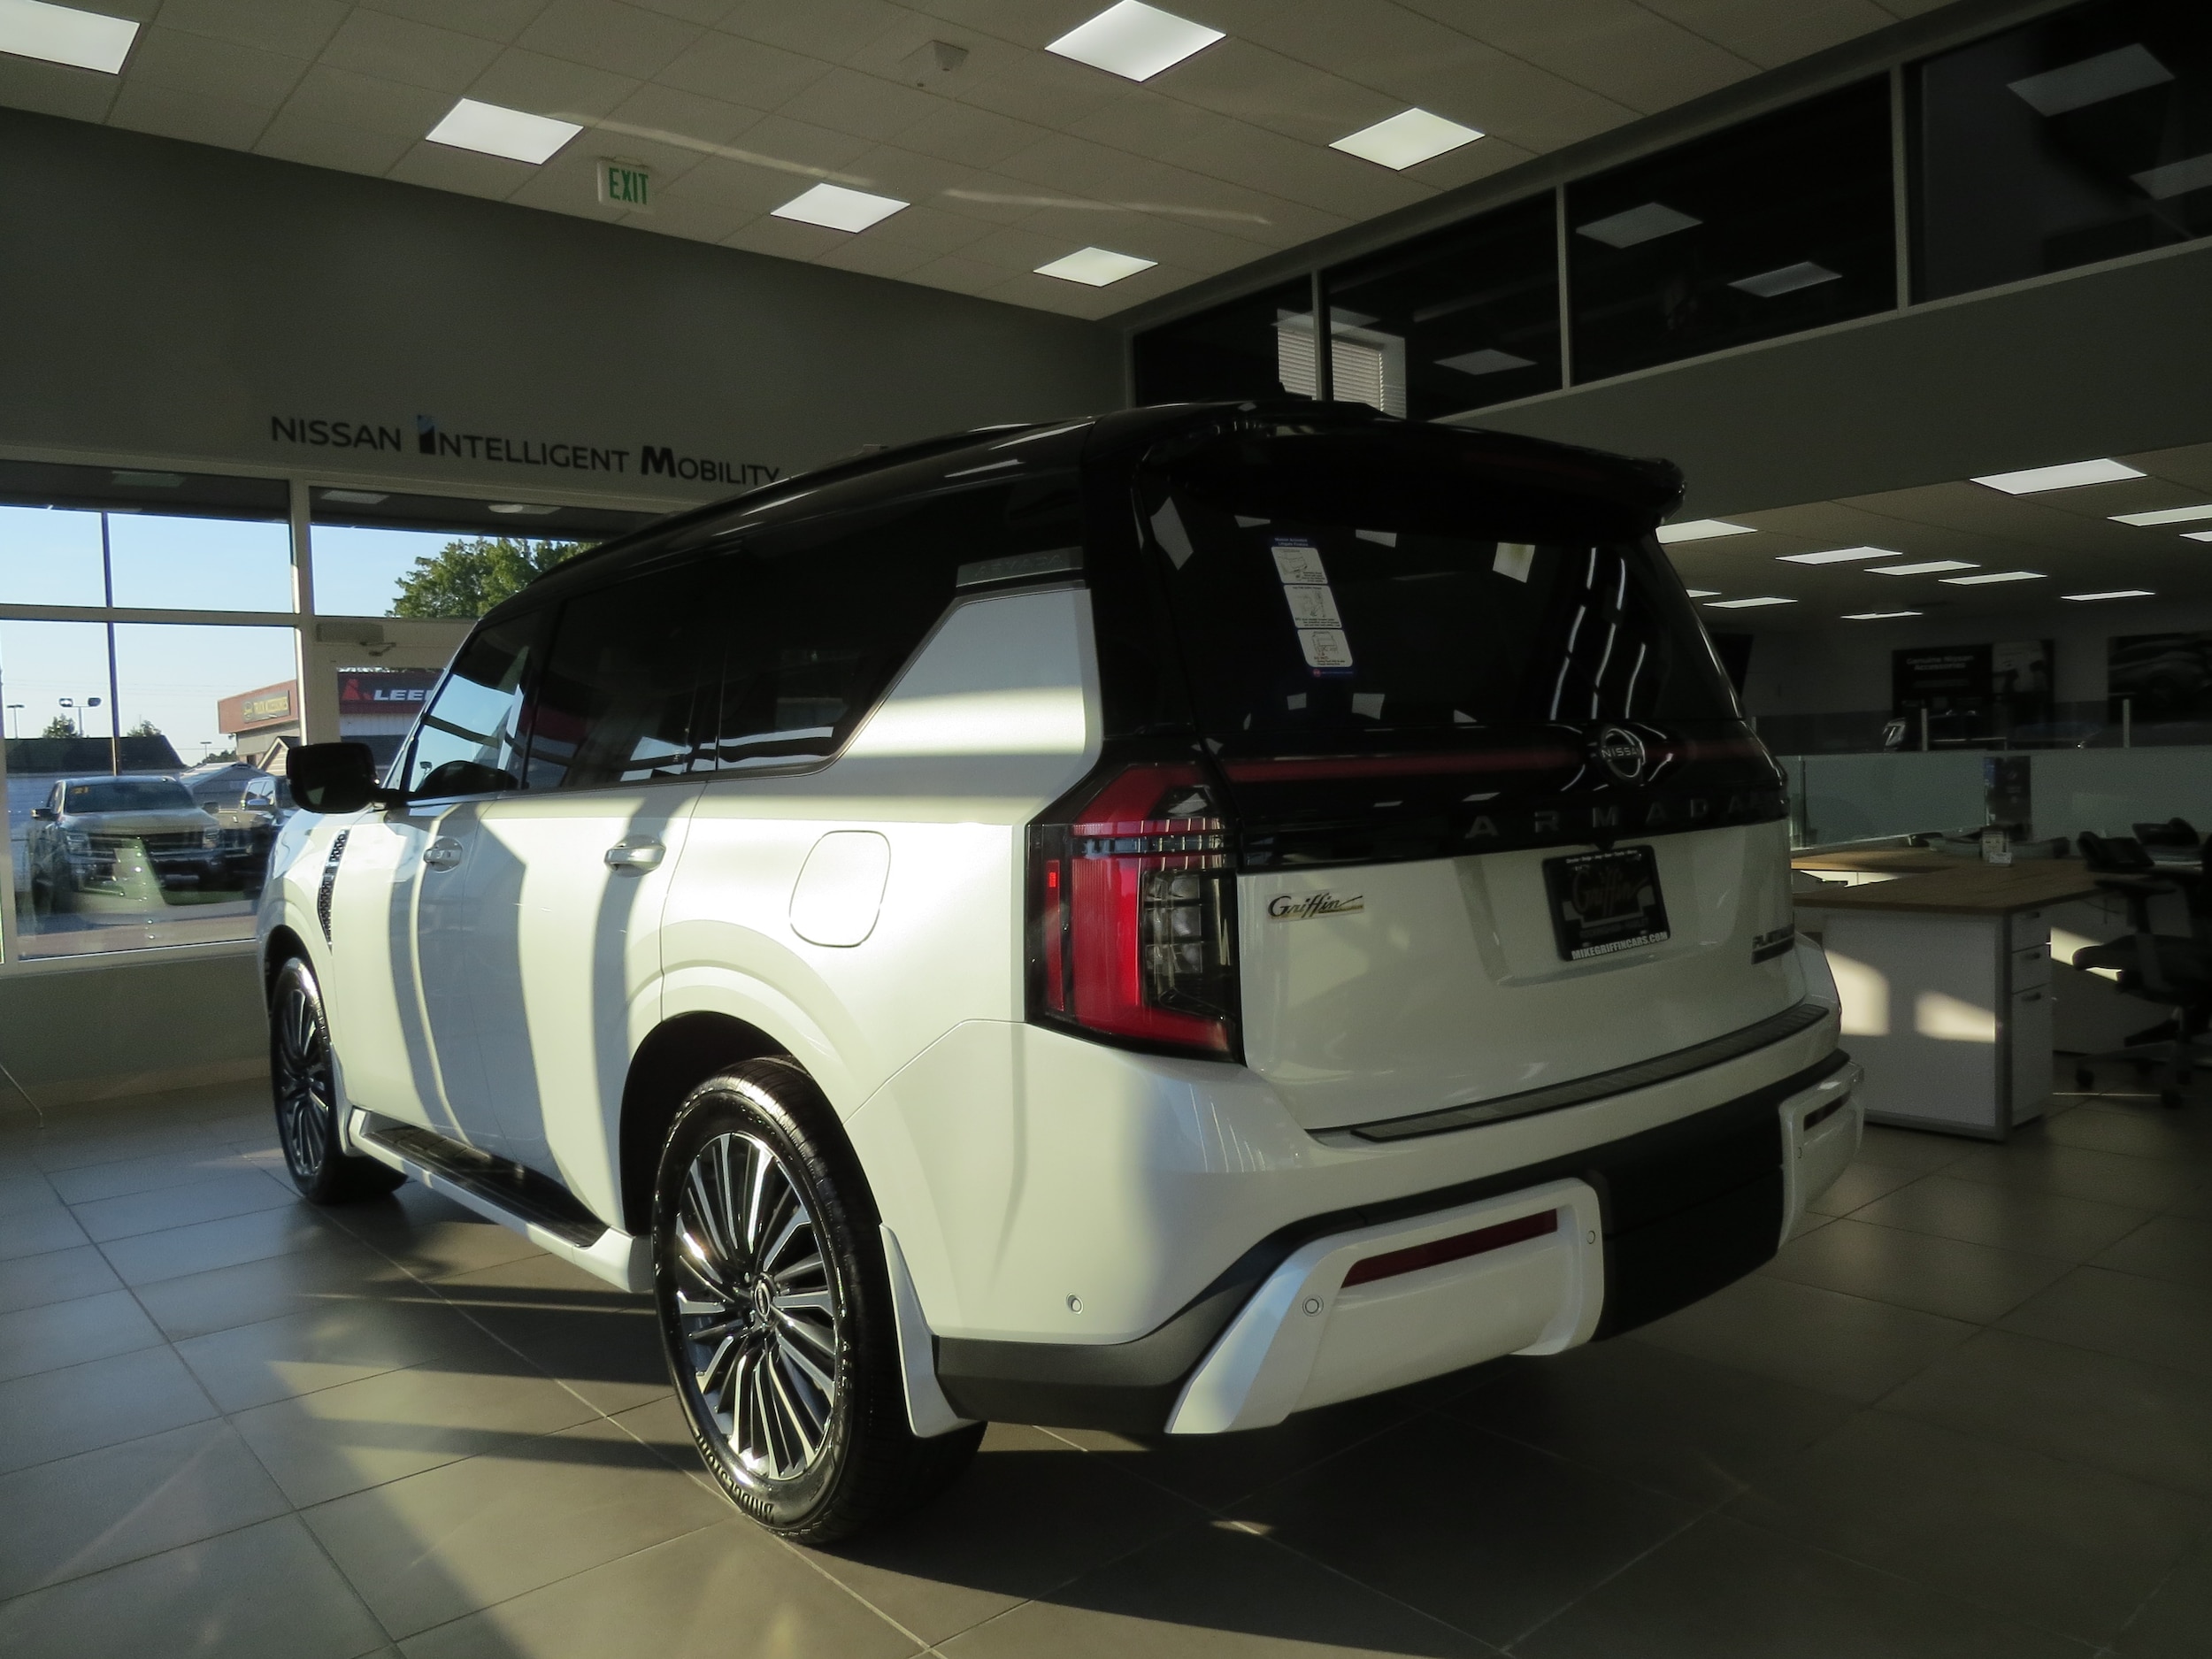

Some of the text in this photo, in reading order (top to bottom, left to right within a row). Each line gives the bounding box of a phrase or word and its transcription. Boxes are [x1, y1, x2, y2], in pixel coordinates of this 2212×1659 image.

[609, 167, 649, 205] EXIT
[272, 414, 780, 485] NISSAN INTELLIGENT MOBILITY
[1464, 795, 1744, 838] ARMADA
[1268, 893, 1363, 918] Griffin
[1571, 932, 1669, 960] MIKEGRIFFINCARS.COM
